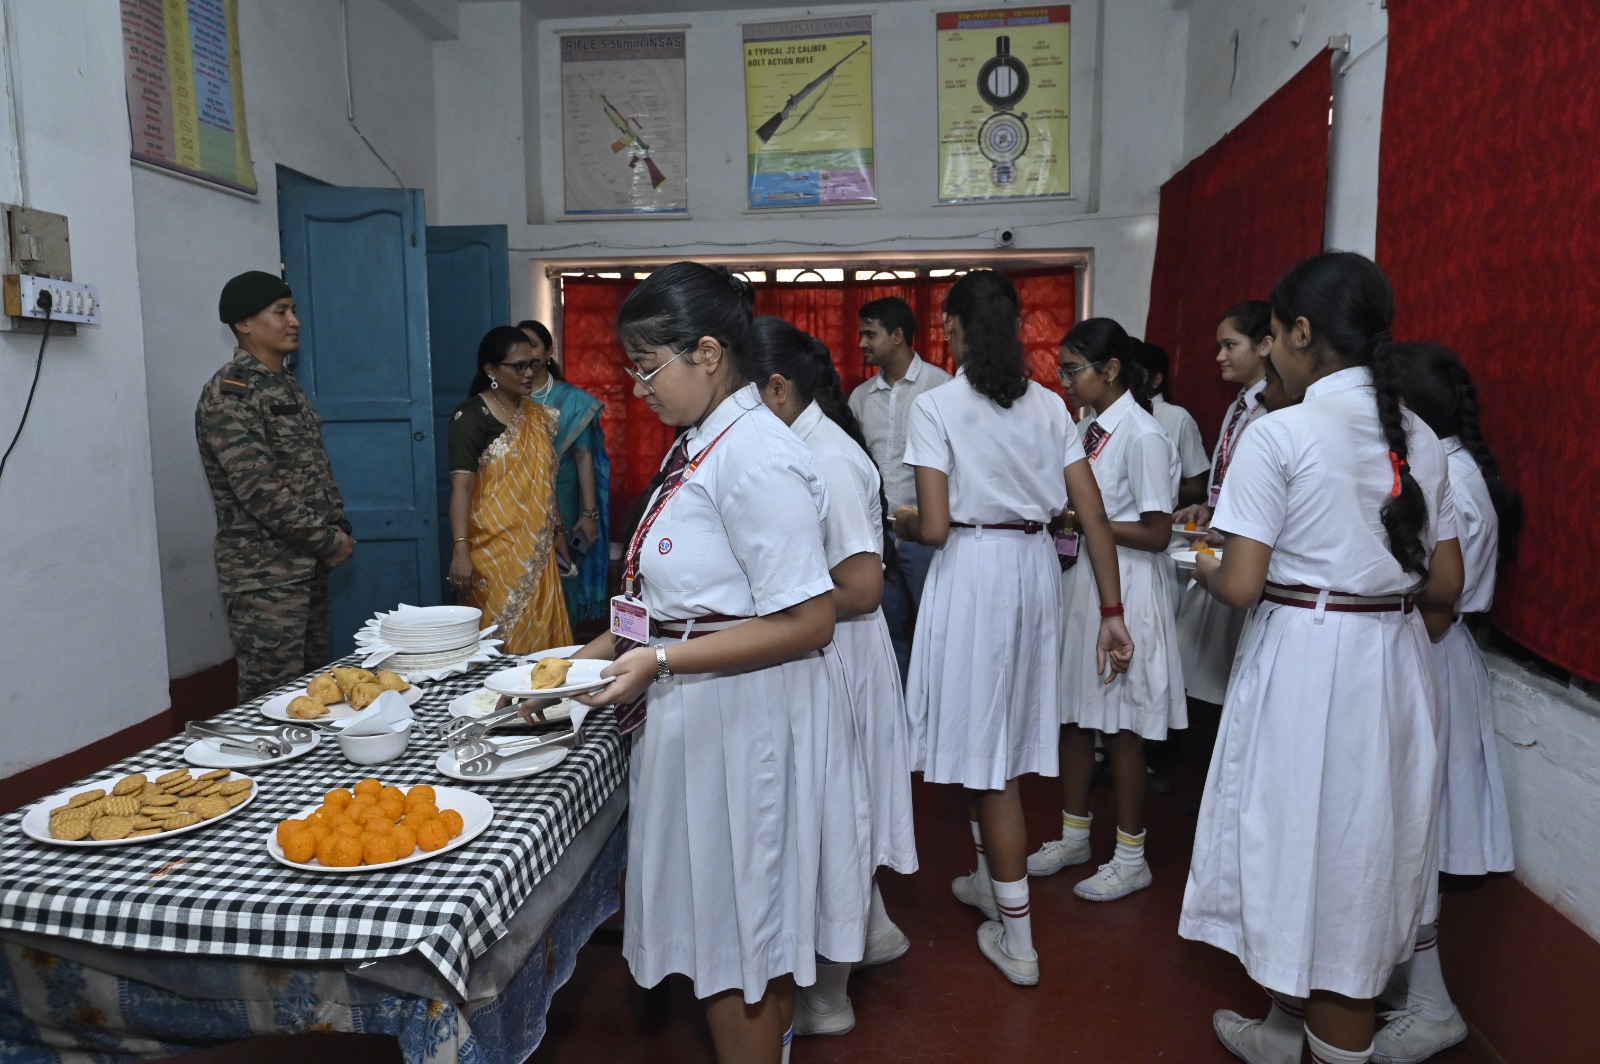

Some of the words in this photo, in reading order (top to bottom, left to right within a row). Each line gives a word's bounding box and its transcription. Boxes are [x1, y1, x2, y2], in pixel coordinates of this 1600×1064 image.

[805, 22, 821, 33] AND
[565, 39, 597, 50] RIFLE
[601, 38, 643, 50] 5.56mm
[646, 36, 681, 49] INSAS
[747, 48, 753, 57] A
[754, 46, 783, 56] TYPICAL
[786, 45, 796, 55] .22
[797, 44, 827, 54] CALIBER
[748, 58, 766, 68] BOLT
[767, 57, 795, 67] ACTION
[795, 56, 814, 66] RIFLE
[659, 485, 680, 508] SCHOOL
